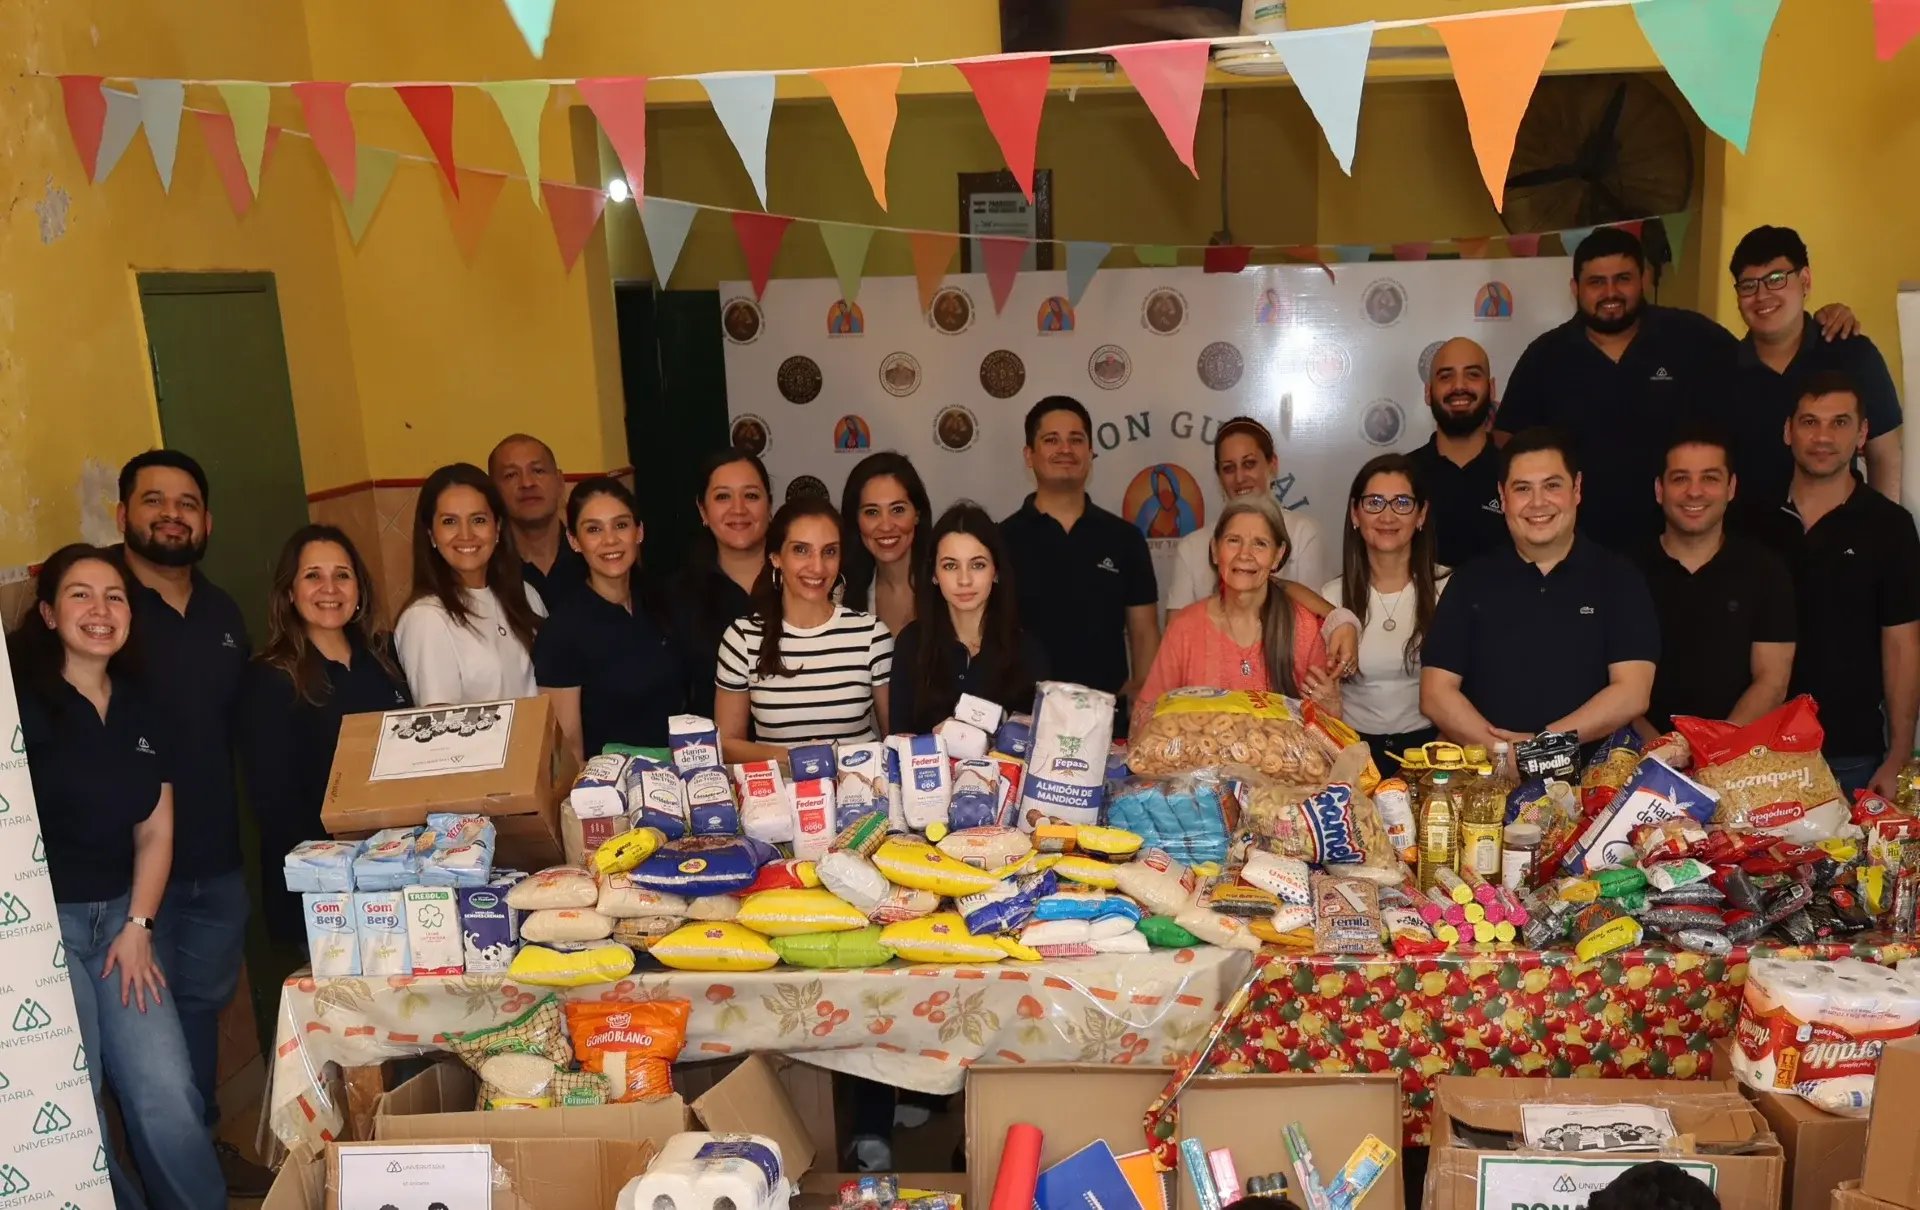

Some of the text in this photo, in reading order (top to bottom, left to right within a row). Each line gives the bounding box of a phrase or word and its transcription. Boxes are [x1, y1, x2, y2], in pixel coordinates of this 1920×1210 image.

[912, 756, 940, 767] Federal
[1055, 758, 1088, 769] Fepasa
[1527, 759, 1538, 773] El
[1538, 754, 1571, 774] pocillo
[744, 771, 773, 780] Federal
[1724, 767, 1812, 789] Tirabuzón
[1036, 781, 1093, 798] ALMIDÓN DE
[796, 799, 824, 809] Federal
[1037, 790, 1088, 807] MANDIOCA
[1750, 806, 1802, 823] Campobelo
[316, 903, 340, 913] Som
[367, 903, 393, 913] Som
[316, 915, 342, 926] Berg
[367, 915, 394, 926] Berg
[13, 1127, 93, 1154] UNIVERSITARIA
